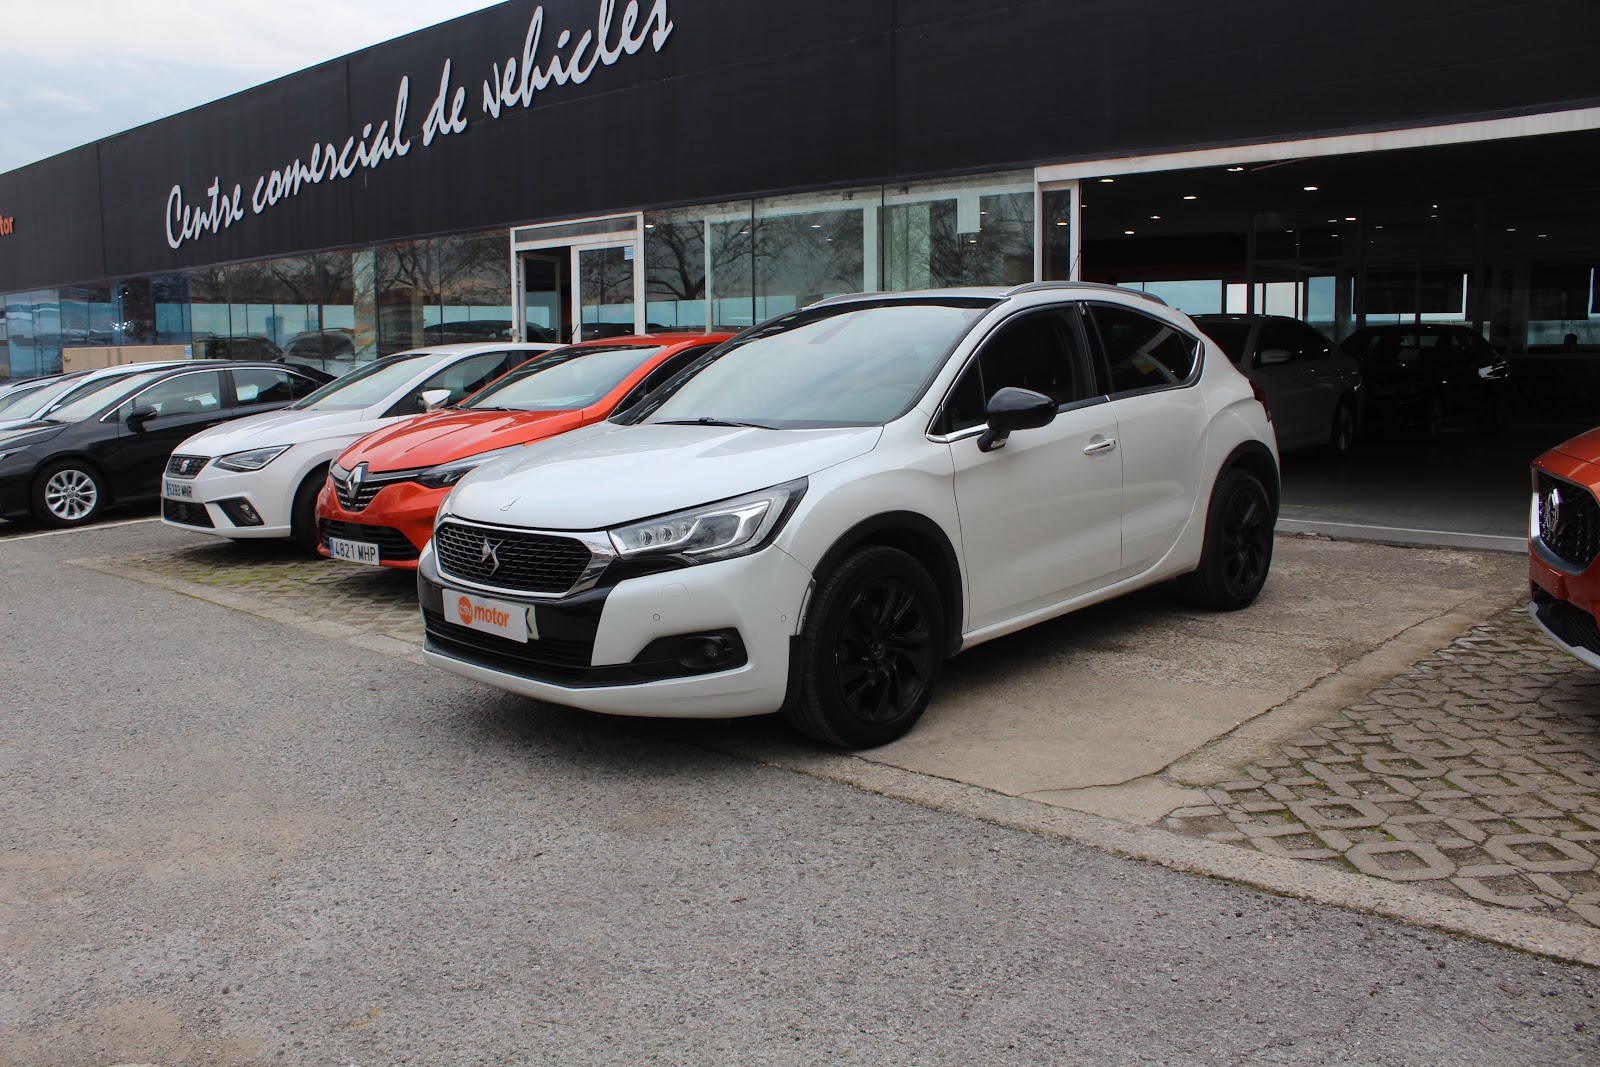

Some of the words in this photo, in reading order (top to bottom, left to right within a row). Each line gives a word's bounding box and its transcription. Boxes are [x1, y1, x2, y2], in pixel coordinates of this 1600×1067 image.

[166, 176, 244, 249] Centre
[252, 75, 411, 214] comercial
[422, 58, 468, 147] de
[482, 0, 674, 119] vehicles
[335, 541, 355, 559] 4821
[357, 544, 376, 562] MHP
[474, 606, 509, 627] motor
